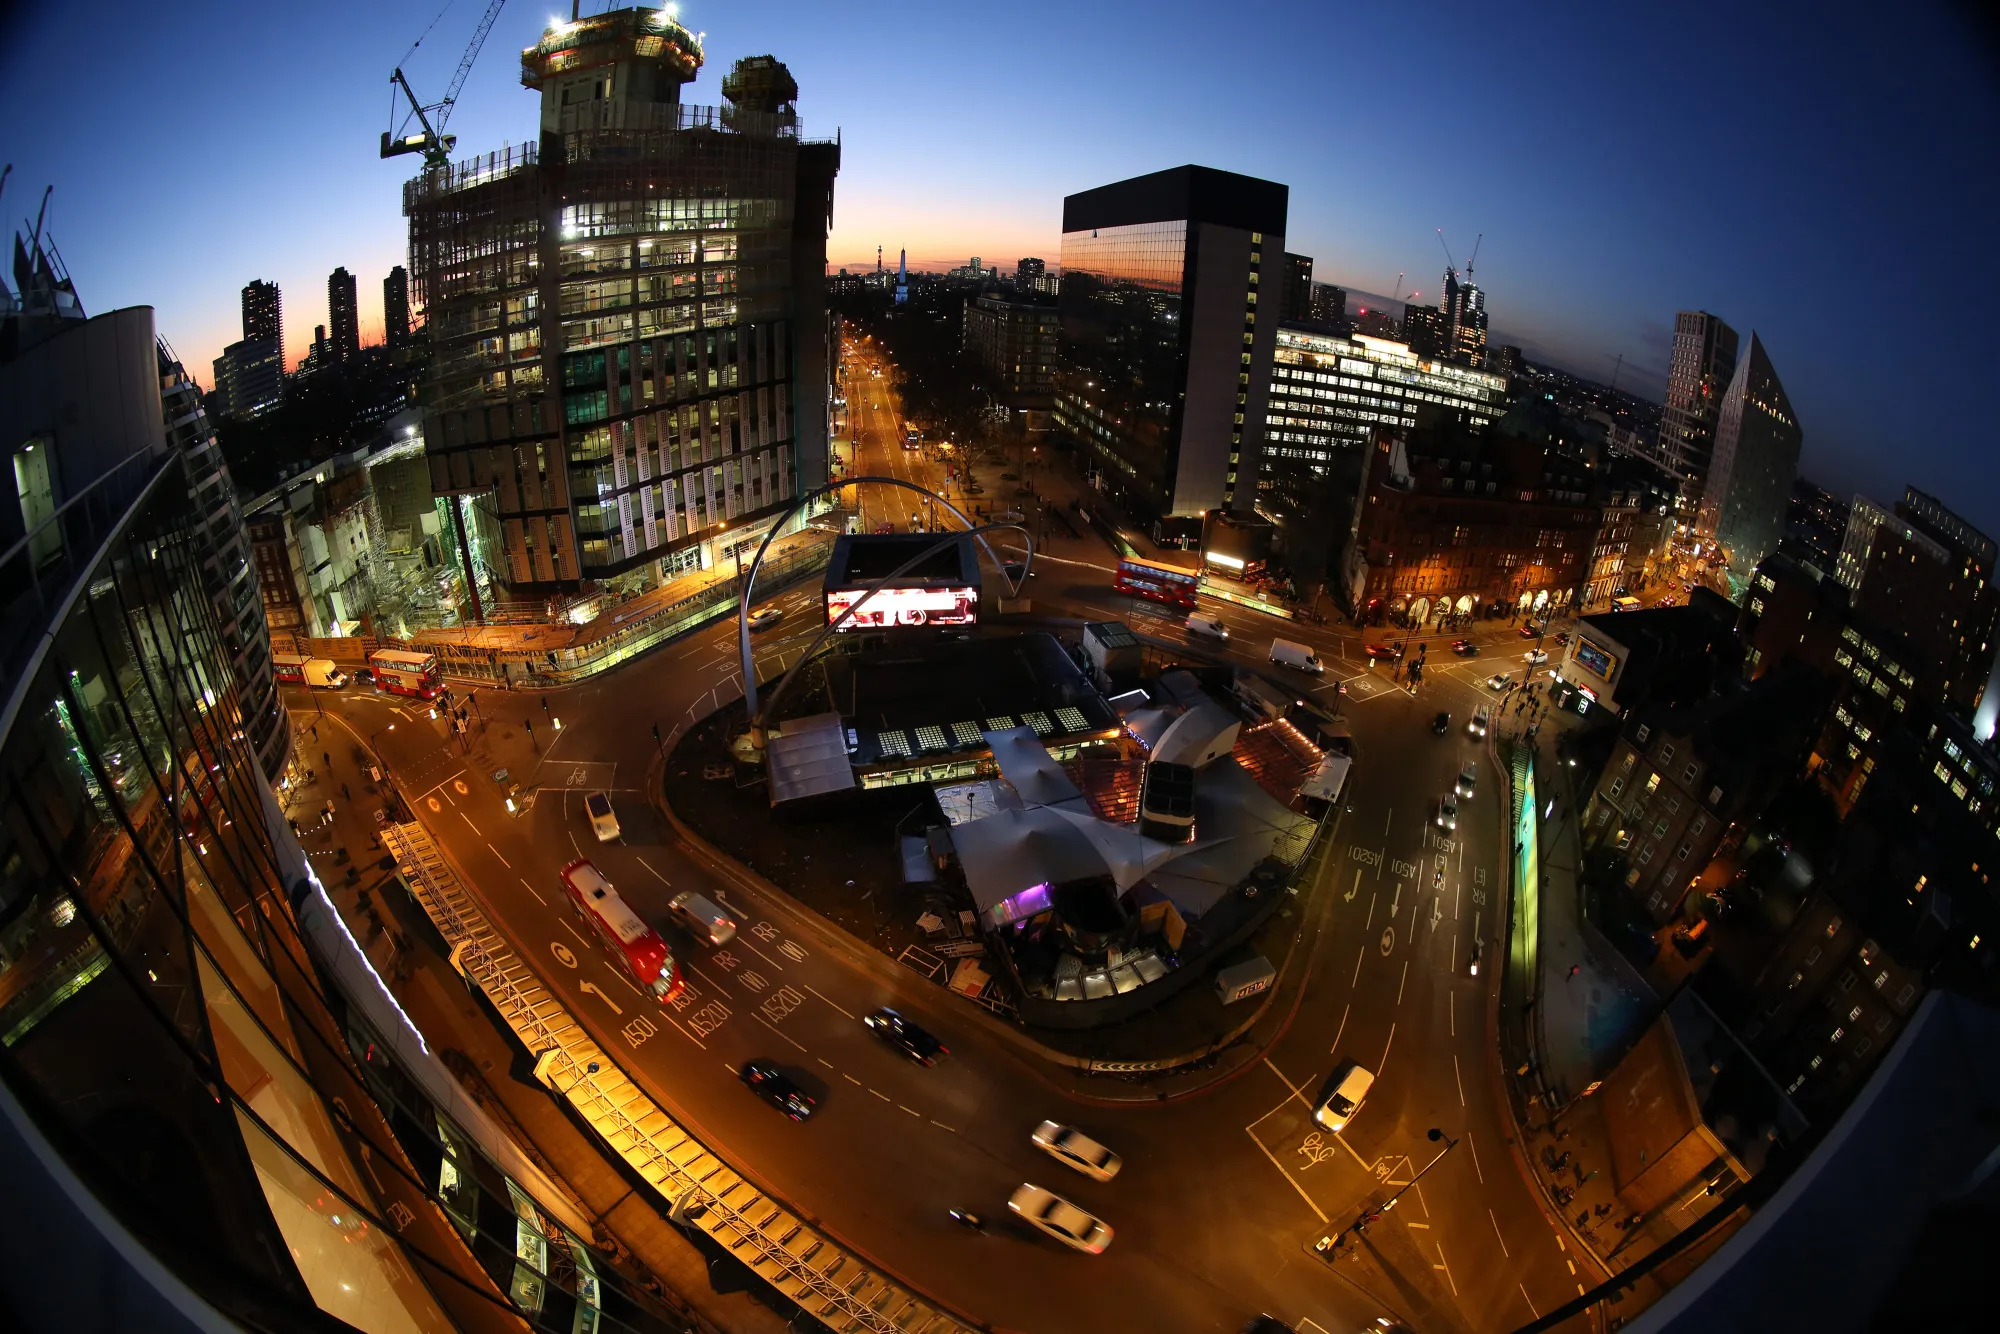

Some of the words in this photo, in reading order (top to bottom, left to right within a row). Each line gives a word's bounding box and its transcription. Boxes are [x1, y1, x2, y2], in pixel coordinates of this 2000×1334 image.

[1432, 834, 1456, 853] A501
[1348, 845, 1382, 867] A5201
[1391, 858, 1417, 879] A501
[1474, 865, 1486, 886] (E)
[1473, 887, 1486, 906] RR
[751, 921, 780, 942] RR
[712, 950, 740, 972] RR
[776, 939, 809, 962] (W)
[737, 968, 769, 993] (W)
[759, 984, 807, 1024] A5201
[687, 999, 733, 1038] A5201
[621, 1014, 658, 1049] A501
